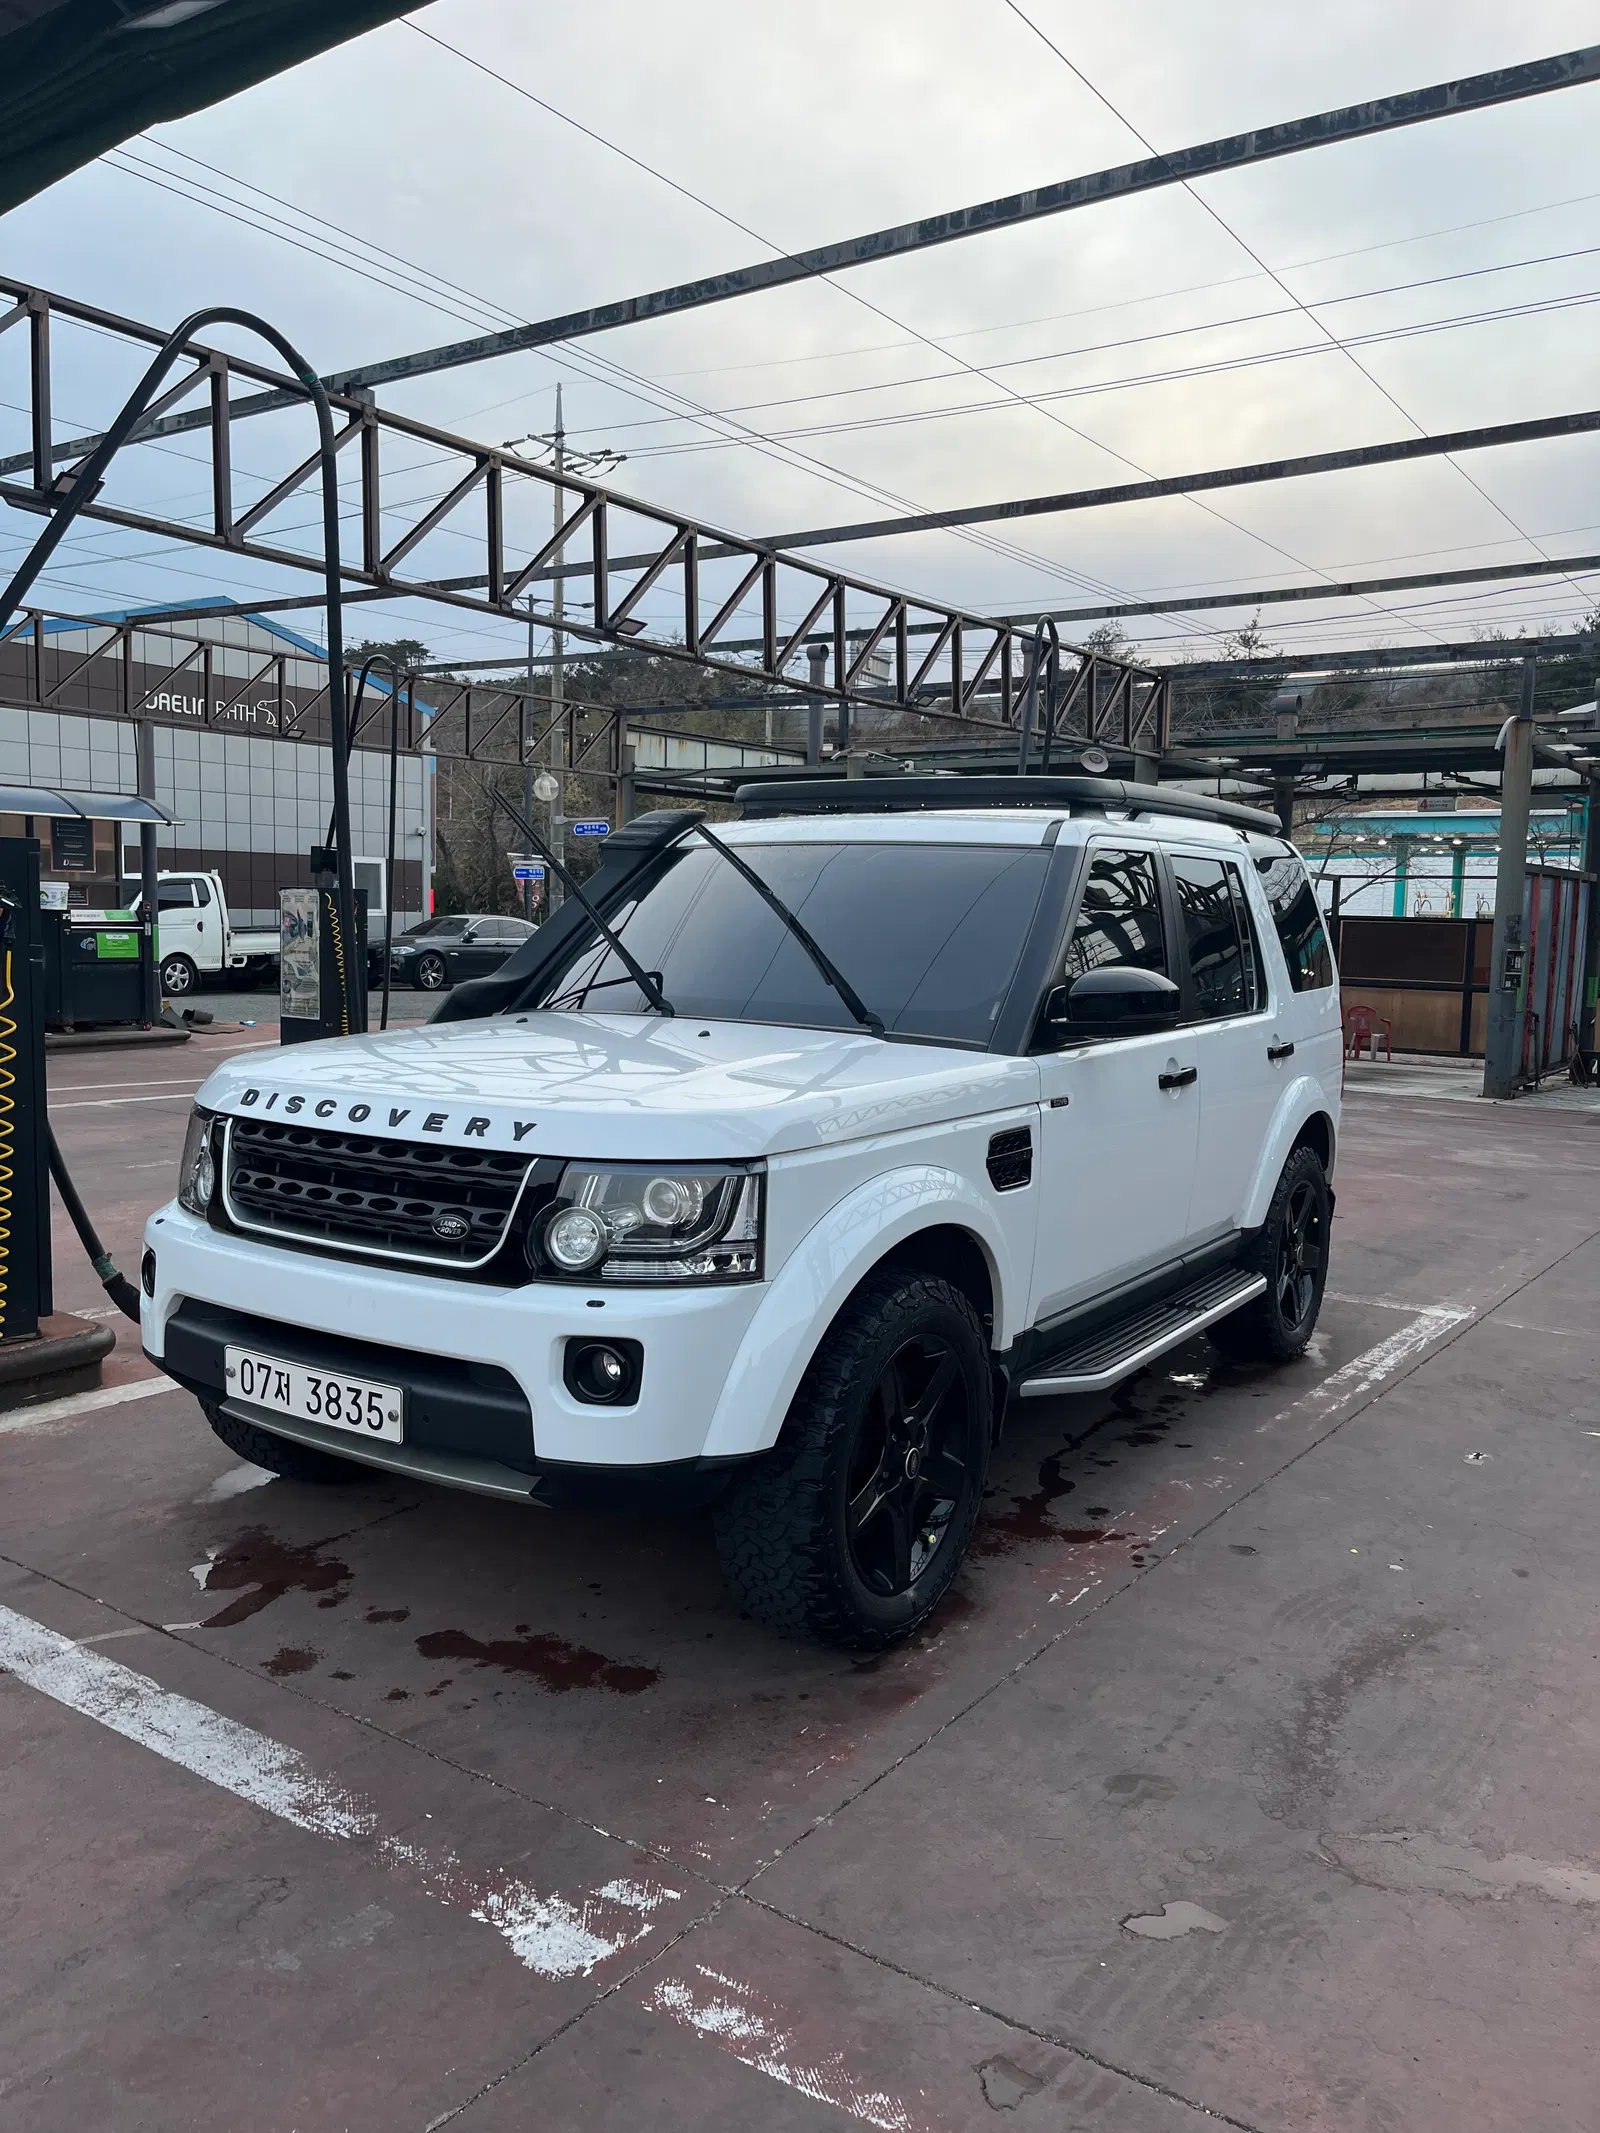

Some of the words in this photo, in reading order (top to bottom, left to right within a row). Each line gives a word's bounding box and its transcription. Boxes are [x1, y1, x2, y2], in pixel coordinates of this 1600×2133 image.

[239, 1088, 537, 1142] DISCOVERY
[440, 1219, 458, 1228] LAND
[440, 1226, 462, 1235] ROVER
[240, 1358, 291, 1406] 07저
[306, 1375, 384, 1431] 3835
